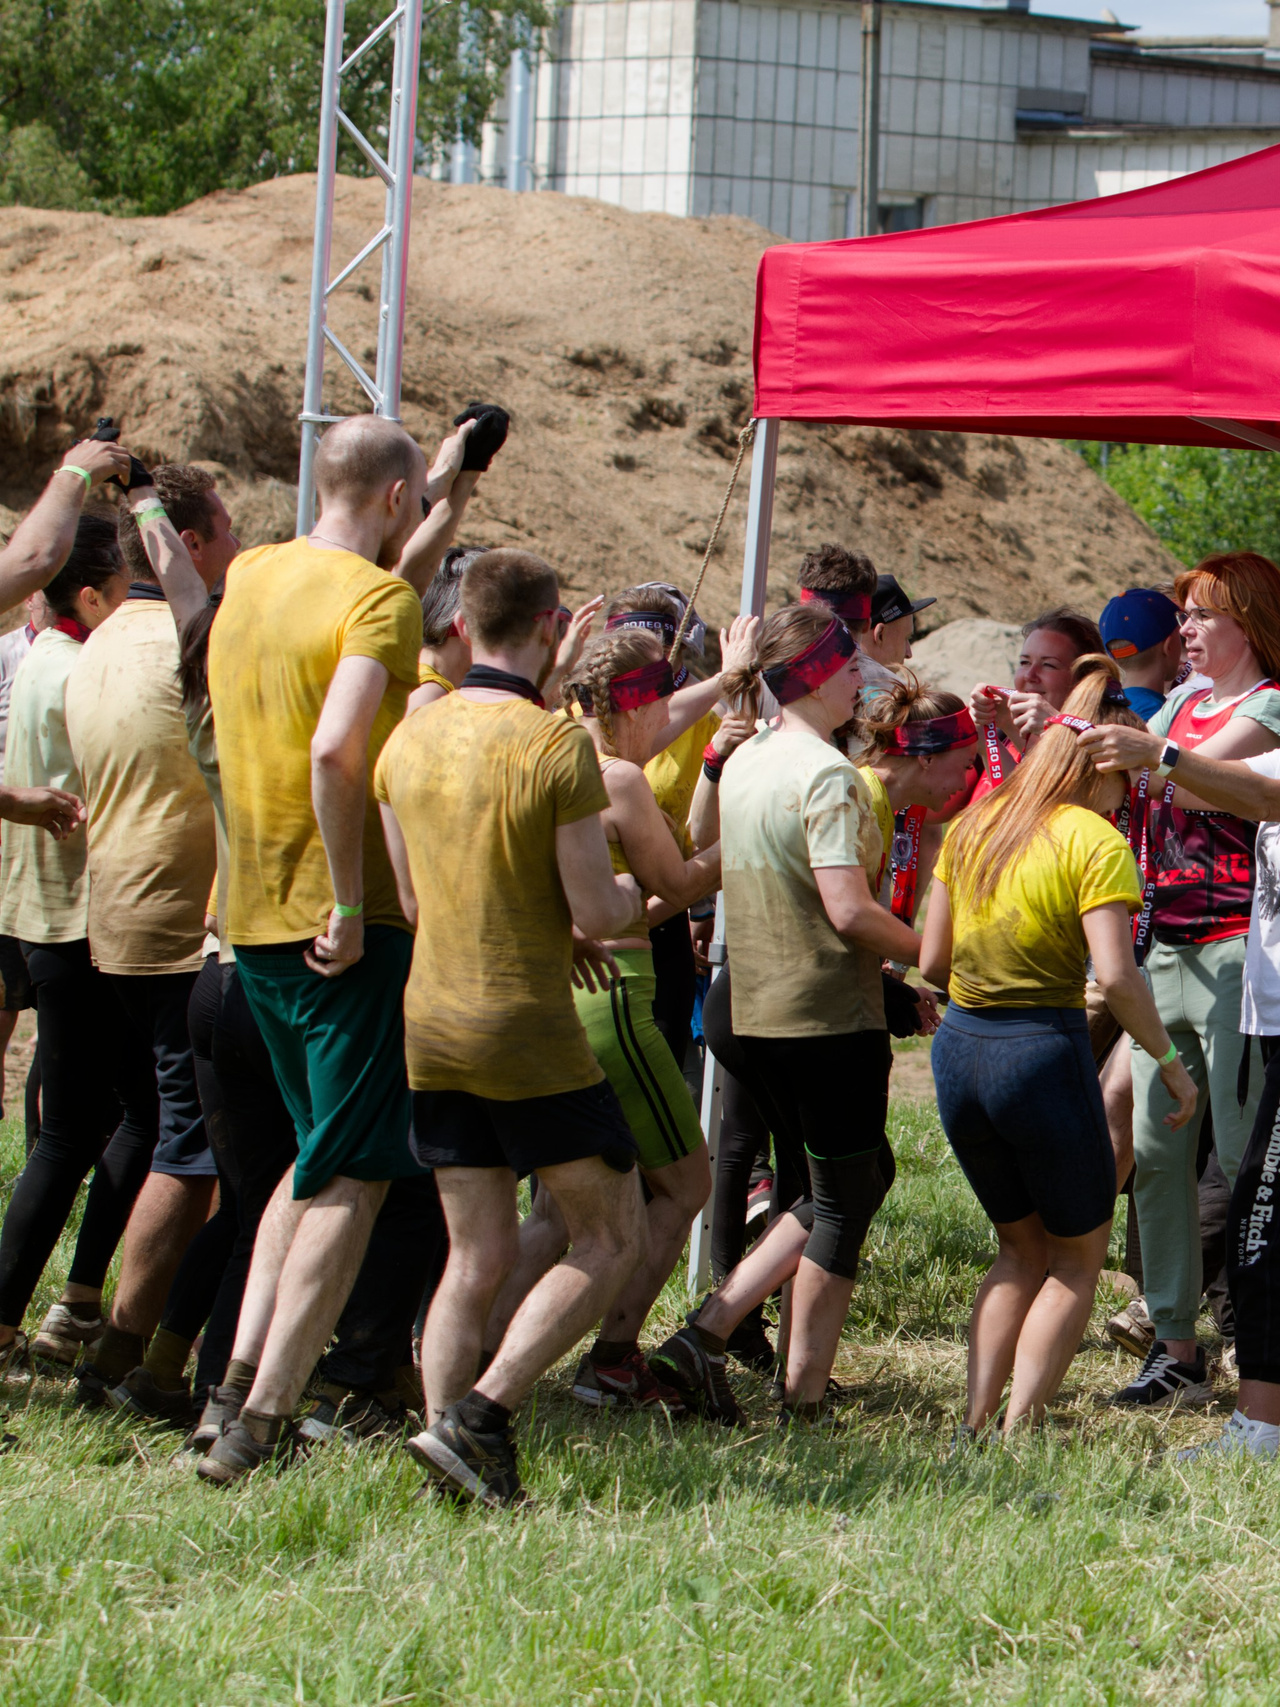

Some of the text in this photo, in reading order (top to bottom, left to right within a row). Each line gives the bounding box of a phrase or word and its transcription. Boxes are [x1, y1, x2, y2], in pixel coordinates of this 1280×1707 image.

[984, 722, 1002, 779] РОДЕО 59
[1136, 882, 1156, 946] РОДЕО 59
[1256, 1185, 1273, 1202] &
[1246, 1203, 1274, 1252] Fitch
